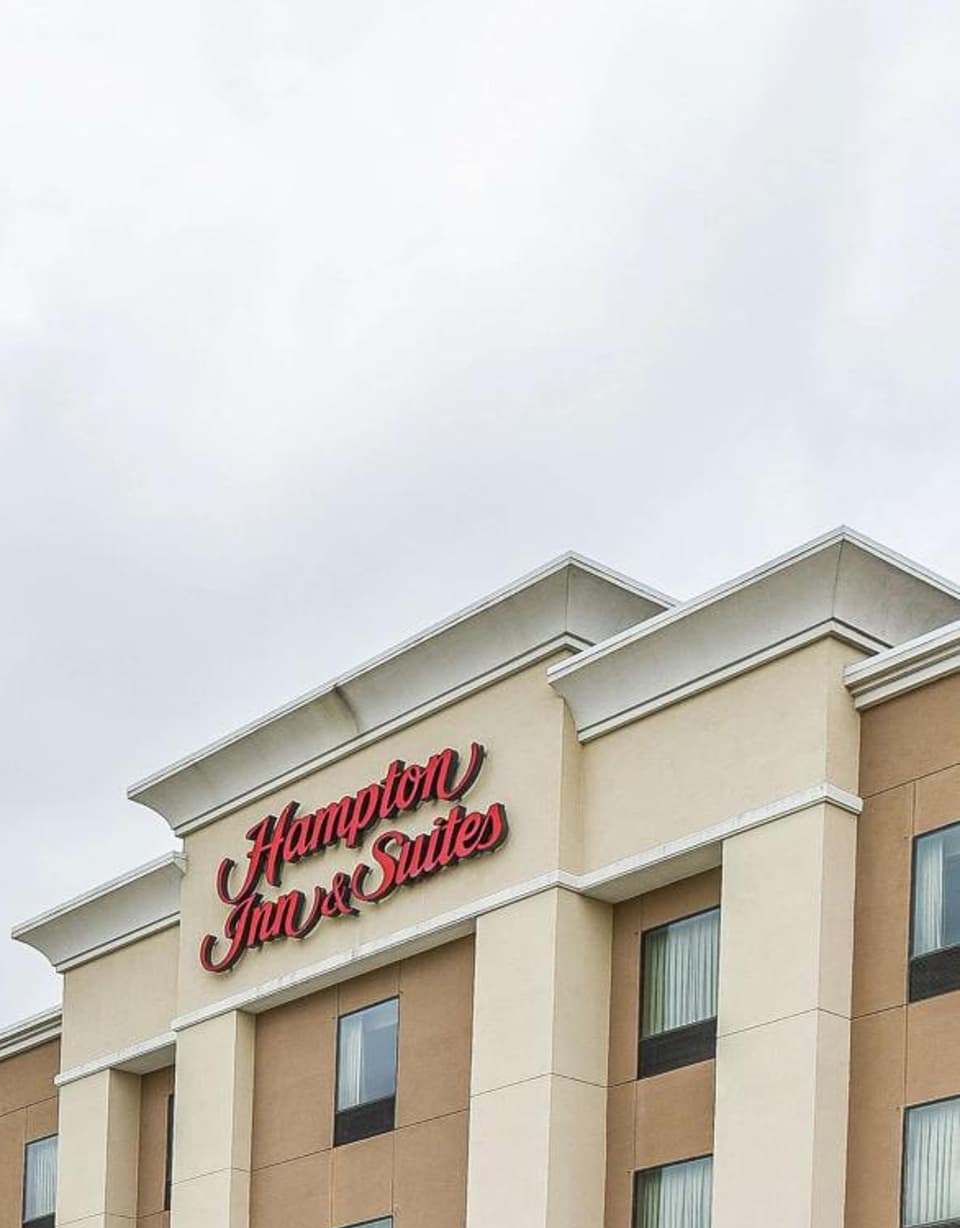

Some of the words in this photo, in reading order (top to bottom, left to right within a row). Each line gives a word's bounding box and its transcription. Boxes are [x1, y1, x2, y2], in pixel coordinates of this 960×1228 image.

[200, 886, 325, 973] Inn
[321, 872, 359, 917] &
[351, 802, 508, 902] Suites
[216, 741, 487, 905] Hampton
